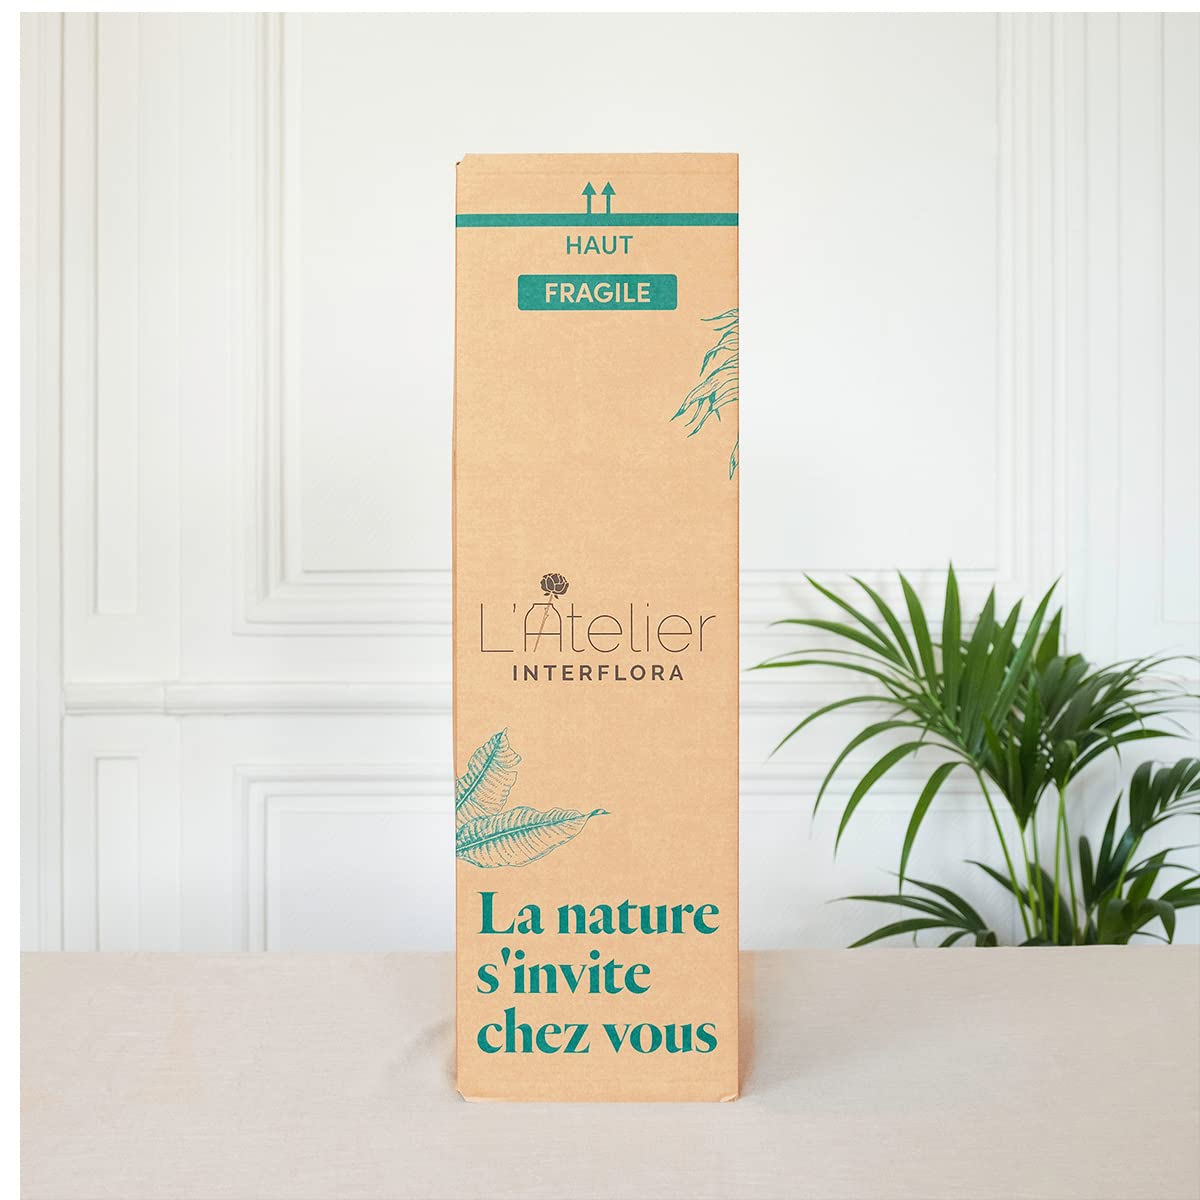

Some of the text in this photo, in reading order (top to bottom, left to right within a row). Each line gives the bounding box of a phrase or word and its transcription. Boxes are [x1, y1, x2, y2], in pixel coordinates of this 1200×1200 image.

[565, 235, 633, 255] HAUT
[545, 282, 651, 304] FRAGILE
[480, 603, 717, 653] L'Atelier
[513, 665, 684, 682] INTERFLORA
[477, 891, 720, 935] La nature
[477, 947, 651, 994] s'invite
[477, 1007, 718, 1054] chez vous
